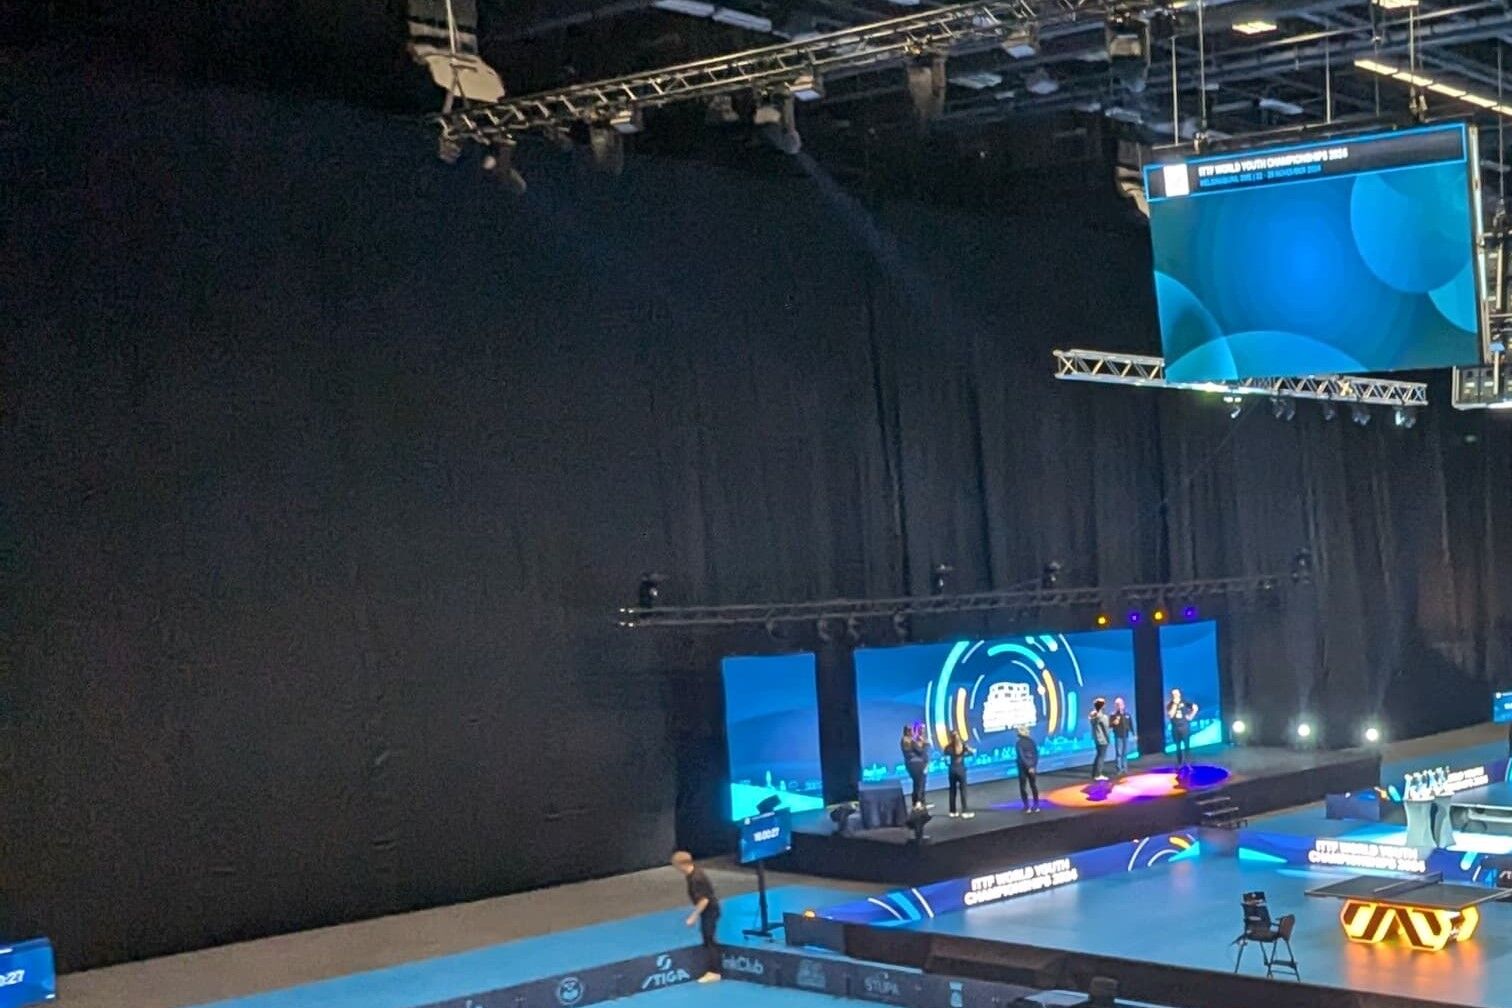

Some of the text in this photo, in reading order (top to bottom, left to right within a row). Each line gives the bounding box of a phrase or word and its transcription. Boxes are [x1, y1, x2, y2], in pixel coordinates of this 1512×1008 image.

[1215, 162, 1241, 175] WORLD
[1241, 159, 1267, 172] YOUTH
[971, 858, 1071, 891] ITTF WORLD YOUTH
[964, 875, 1052, 905] CHAMPIONSHIPS
[641, 968, 690, 990] STIGA
